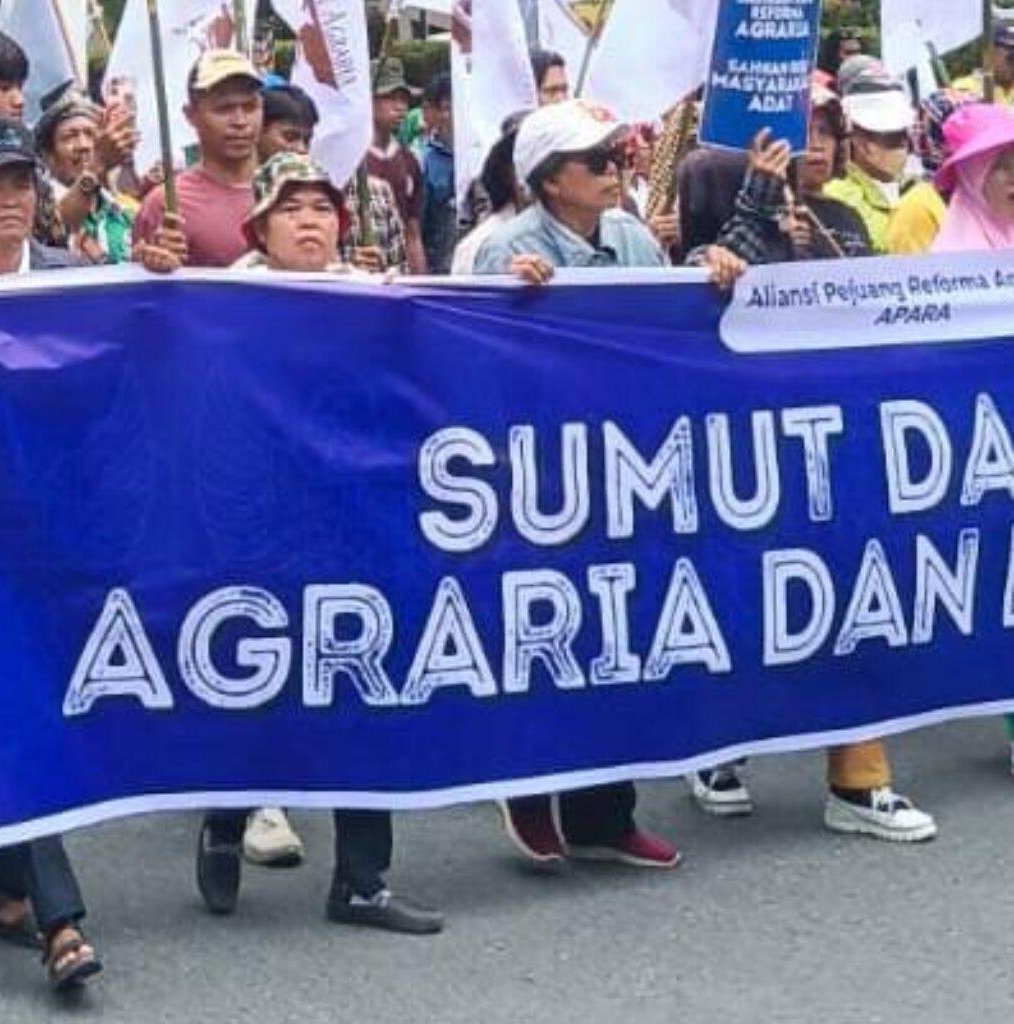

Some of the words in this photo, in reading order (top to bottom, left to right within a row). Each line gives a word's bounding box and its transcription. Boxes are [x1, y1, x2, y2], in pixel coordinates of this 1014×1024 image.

[747, 282, 820, 308] Aliansi
[823, 279, 904, 306] Pejuang
[908, 274, 989, 293] Reforma
[874, 303, 952, 326] APARA
[417, 406, 844, 552] SUMUT
[62, 556, 732, 716] AGRARIA
[762, 528, 980, 668] DAN
